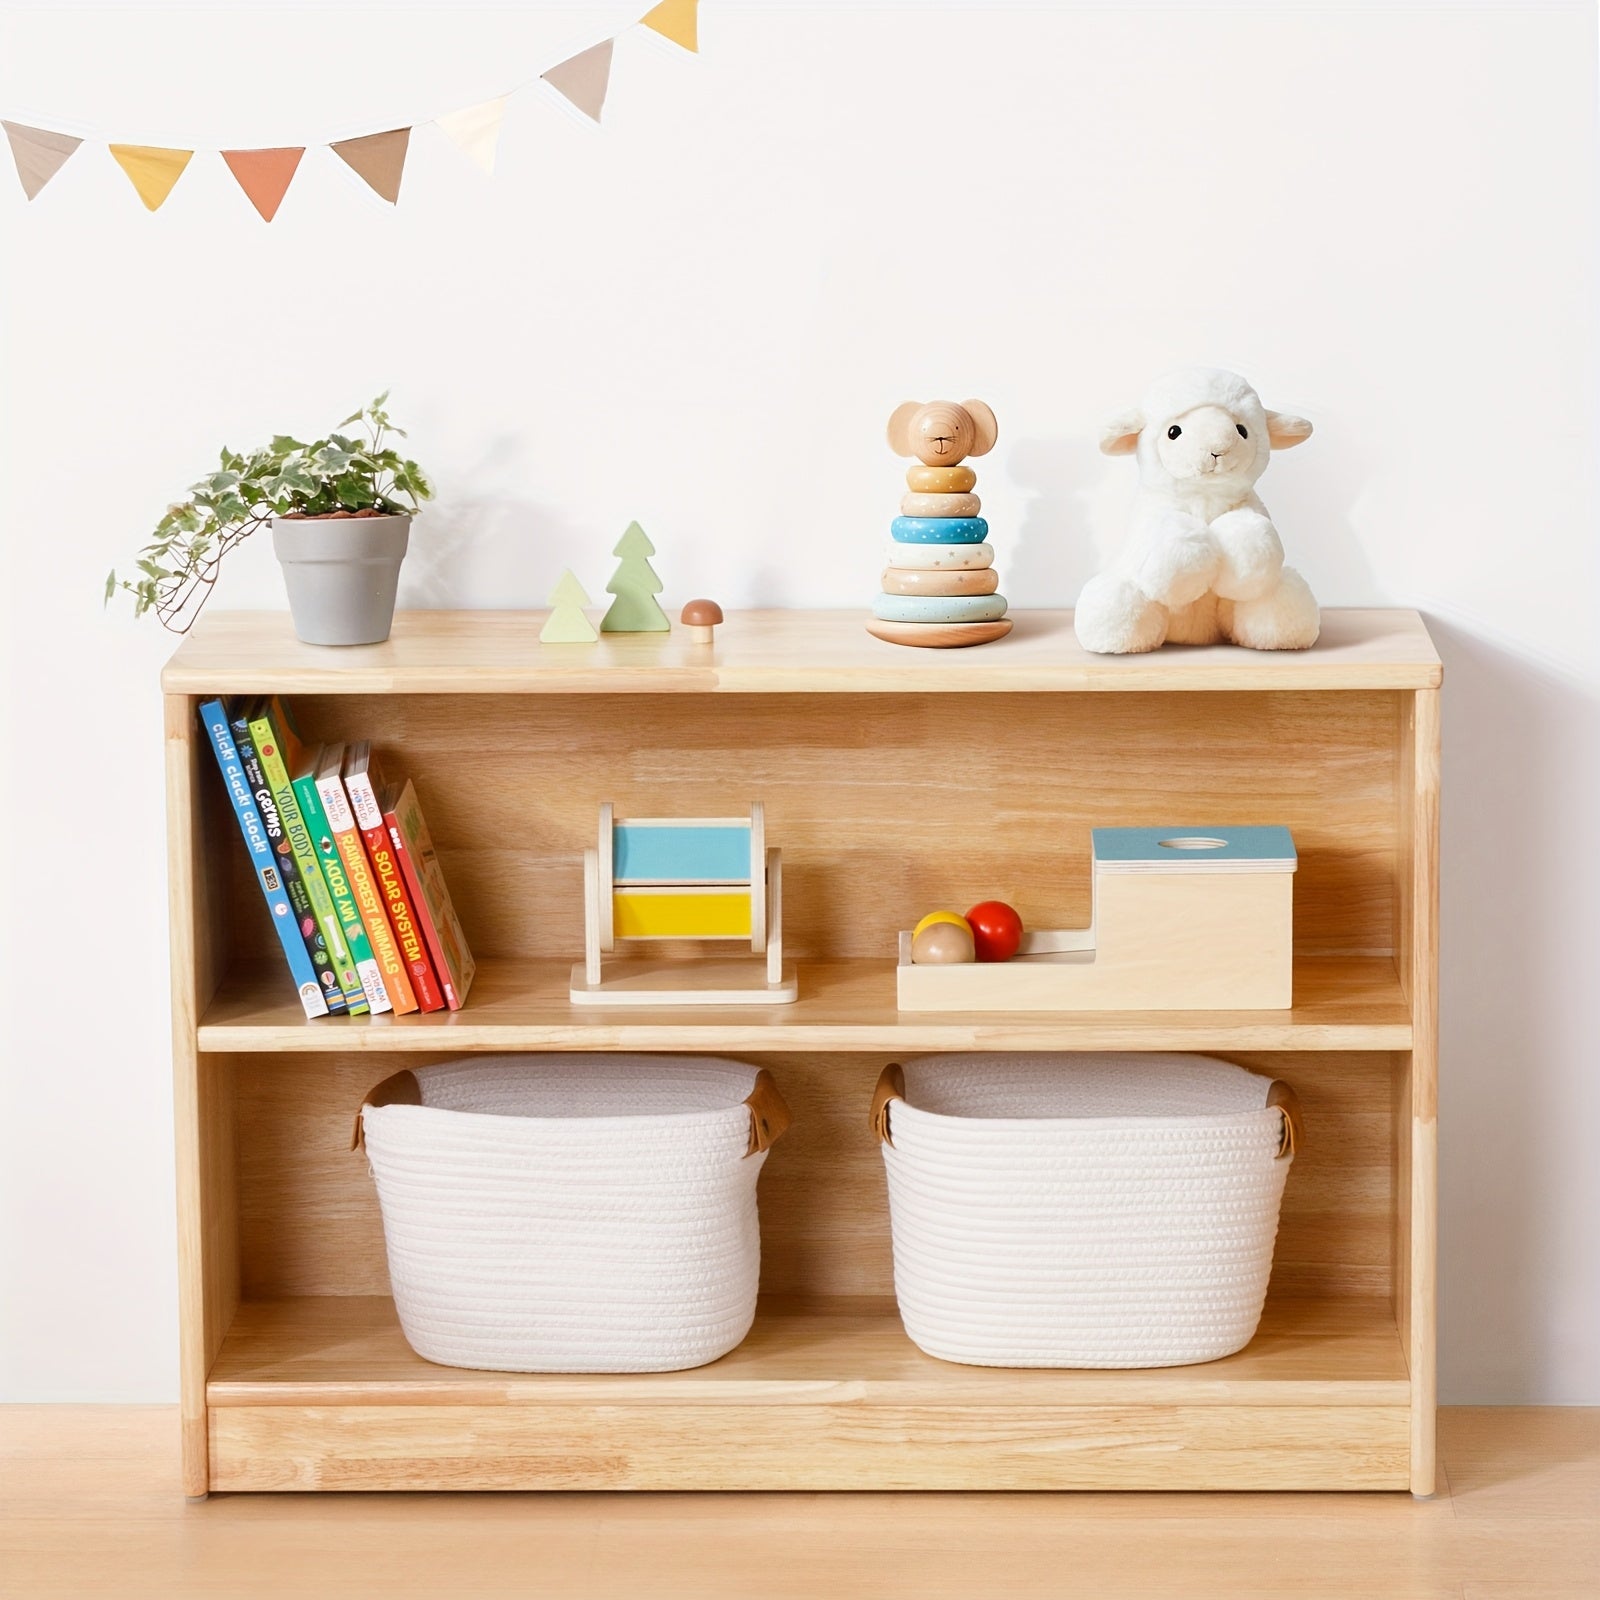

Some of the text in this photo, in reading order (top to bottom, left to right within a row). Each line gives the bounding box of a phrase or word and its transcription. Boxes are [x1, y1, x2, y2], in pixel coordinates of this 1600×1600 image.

[276, 785, 298, 823] YOUR
[288, 824, 313, 858] BODY
[324, 859, 357, 922] MY BODY
[341, 834, 399, 974] RAINFOREST ANIMALS
[375, 851, 421, 961] SOLAR SYSTEM
